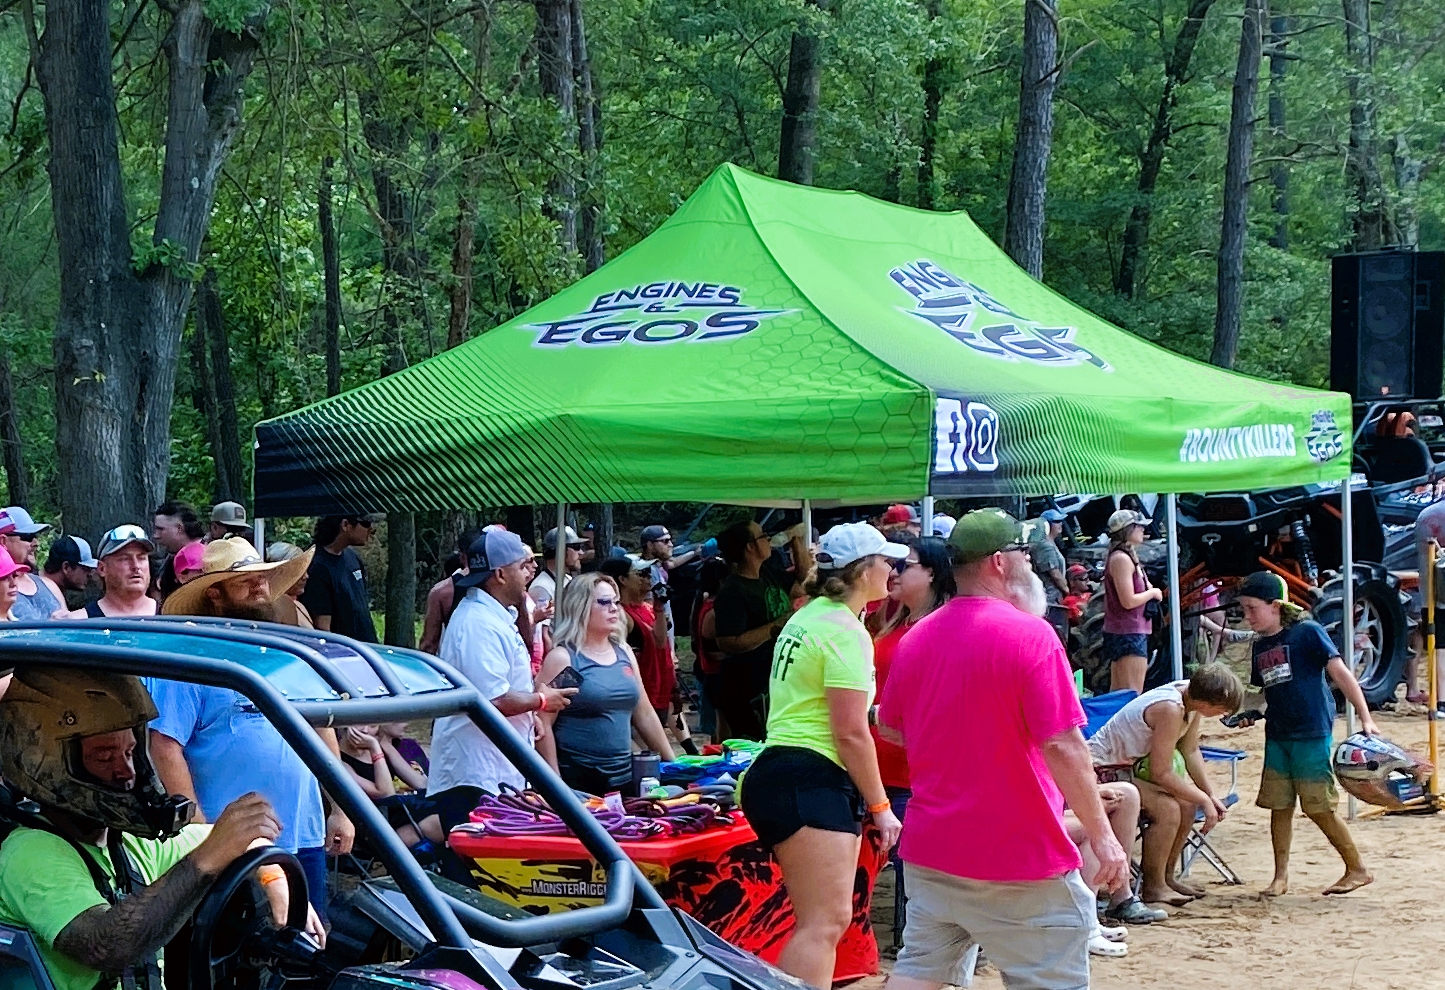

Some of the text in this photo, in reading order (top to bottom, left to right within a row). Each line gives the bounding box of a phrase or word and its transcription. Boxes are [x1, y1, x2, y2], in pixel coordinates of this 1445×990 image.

[589, 281, 743, 313] ENGINES
[529, 308, 780, 345] EGOS
[1179, 423, 1296, 462] #BOUNTYKILLERS
